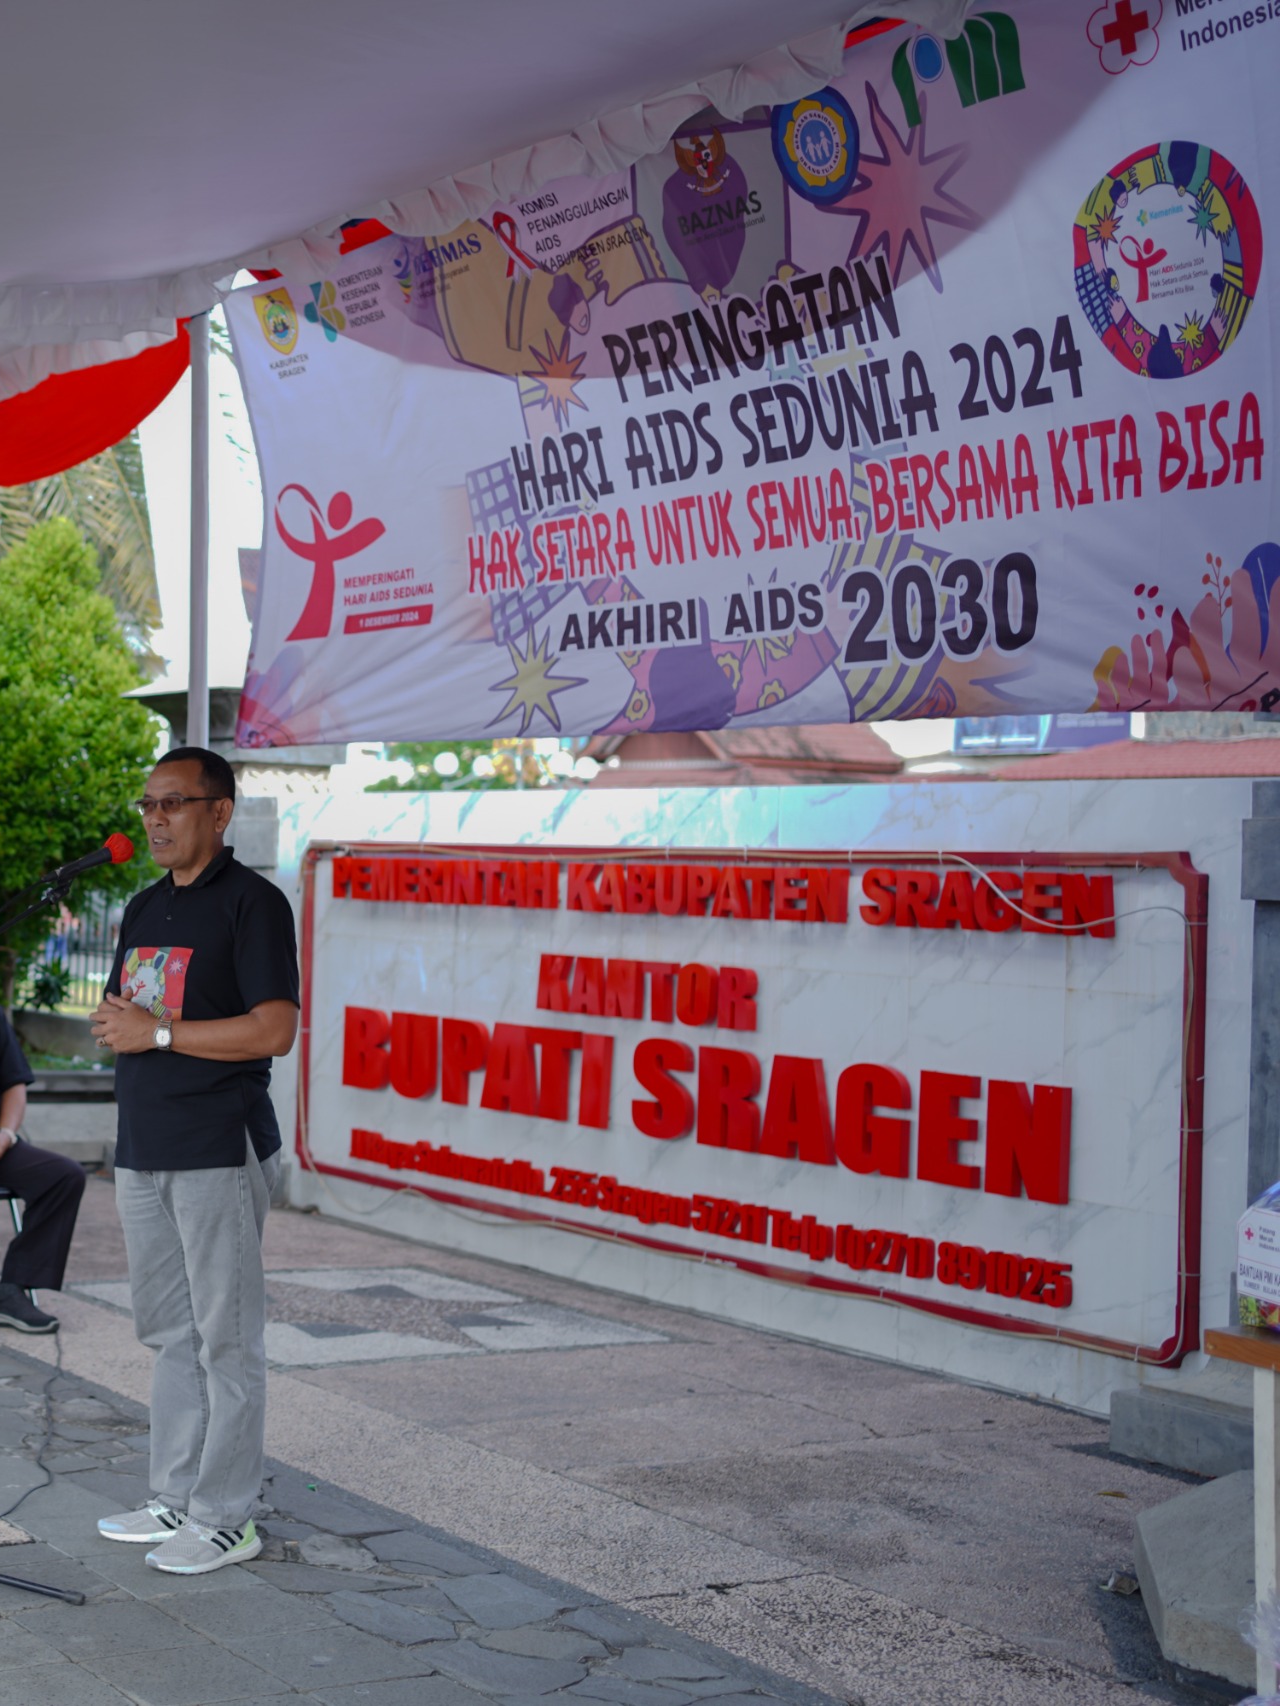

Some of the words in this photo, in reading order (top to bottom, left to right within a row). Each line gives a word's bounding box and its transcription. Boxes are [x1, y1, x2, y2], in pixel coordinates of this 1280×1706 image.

[518, 192, 559, 217] KOMISI
[527, 186, 630, 236] PENANGGULANGAN
[677, 190, 762, 237] BAZNAS
[535, 235, 562, 254] AIDS
[541, 242, 606, 273] KABUPATEN
[606, 226, 650, 252] SRAGEN
[337, 265, 384, 289] KEMENTERIAN
[1149, 267, 1162, 277] Hari
[1162, 264, 1174, 275] AIDS
[1193, 257, 1205, 267] 2024
[341, 282, 381, 302] KESEHATAN
[345, 297, 379, 315] REPUBLIK
[349, 310, 386, 328] INDONESIA
[602, 255, 900, 402] PERINGATAN
[269, 353, 309, 370] KABUPATEN
[278, 366, 307, 380] SRAGEN
[511, 426, 615, 512] HARI
[625, 401, 723, 489] AIDS
[729, 350, 939, 468] SEDUNIA
[949, 314, 1083, 420] 2024
[467, 523, 525, 596] HAK
[531, 503, 636, 584] SETARA
[642, 489, 742, 567] UNTUK
[746, 467, 862, 553] SEMUA,
[864, 433, 1040, 533] BERSAMA
[1047, 414, 1143, 511] KITA
[1155, 391, 1264, 494] BISA
[344, 568, 414, 589] MEMPERINGATI
[344, 593, 367, 606] HARI
[370, 589, 390, 603] AIDS
[393, 582, 434, 600] SEDUNIA
[559, 598, 698, 653] AKHIRI
[725, 583, 824, 636] AIDS
[841, 551, 1038, 664] 2030
[332, 857, 560, 910] PEMERINTAH
[567, 862, 850, 924] KABUPATEN
[859, 867, 1115, 939] SRAGEN
[536, 953, 759, 1031] KANTOR
[342, 1005, 615, 1131] BUPATI
[631, 1038, 1072, 1205] SRAGEN
[598, 1175, 692, 1228] Sragen
[692, 1192, 769, 1244] 57211
[769, 1208, 834, 1261] Telp
[836, 1223, 935, 1279] (0271)
[937, 1241, 1073, 1308] 891025
[1240, 1263, 1263, 1281] BANTUAN
[1264, 1270, 1273, 1284] PMI
